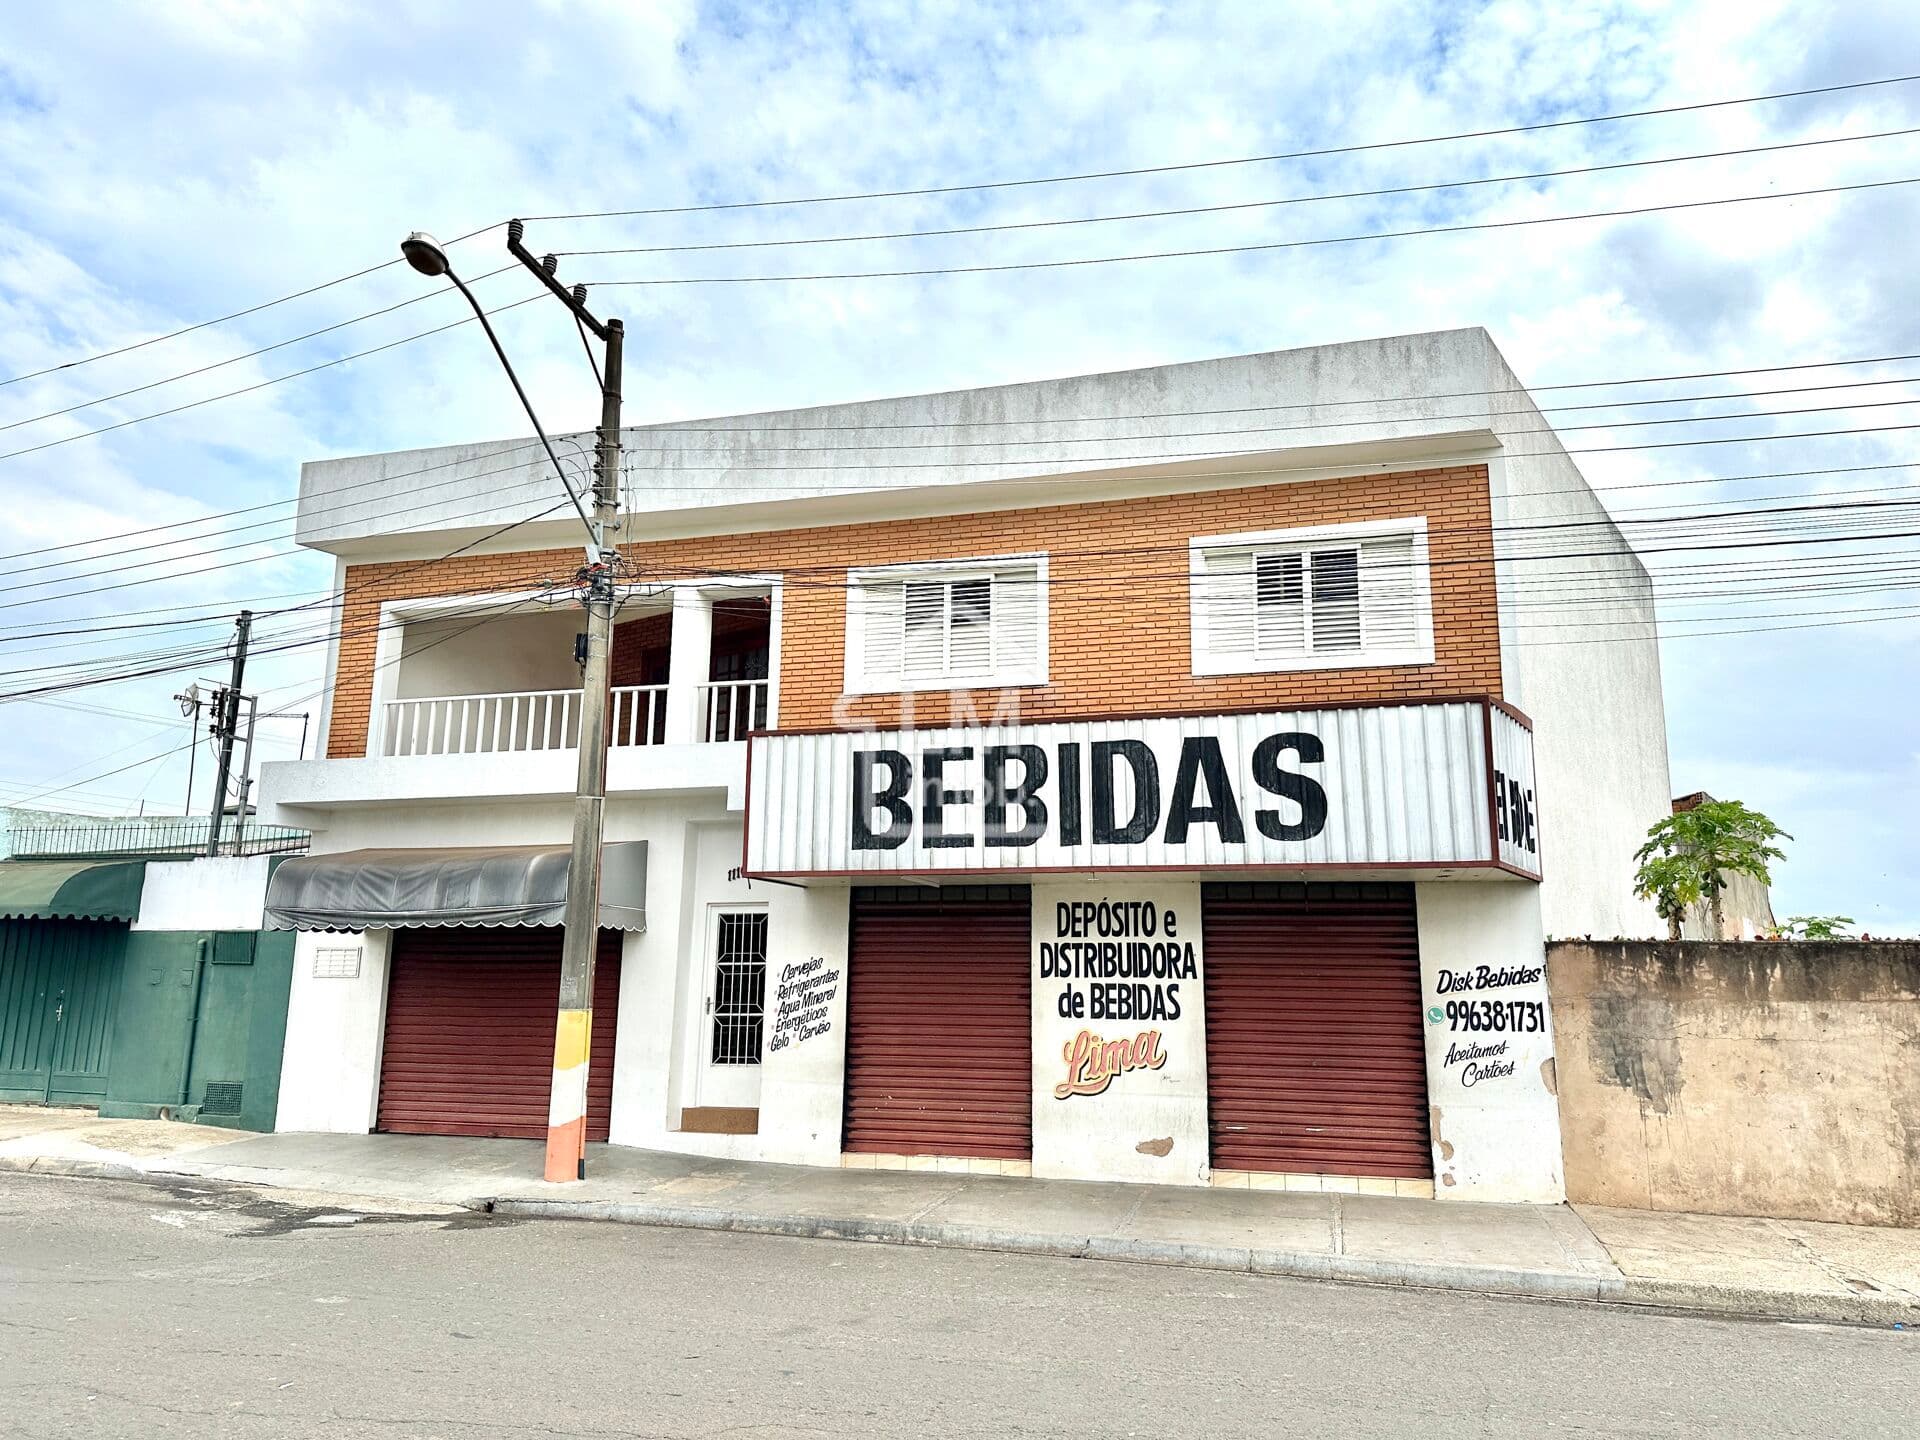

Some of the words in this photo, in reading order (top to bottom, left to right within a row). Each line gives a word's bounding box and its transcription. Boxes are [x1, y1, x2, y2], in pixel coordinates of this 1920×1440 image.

[851, 731, 1328, 850] BEBIDAS
[1056, 896, 1157, 938] DEPÓSITO
[1163, 909, 1177, 938] e
[781, 956, 824, 983] Cervejas
[1040, 942, 1198, 979] DISTRIBUIDORA
[777, 969, 840, 1001] Refrigerantes
[1436, 969, 1474, 994] Disk
[1475, 965, 1542, 990] Bebidas
[801, 984, 838, 1010] Mineral
[1058, 982, 1084, 1018] de
[1090, 983, 1181, 1020] BEBIDAS
[771, 1031, 790, 1052] Gelo
[1443, 1040, 1510, 1069] Aceitamos
[1055, 1030, 1167, 1099] Lima
[1461, 1060, 1517, 1087] Cartões
